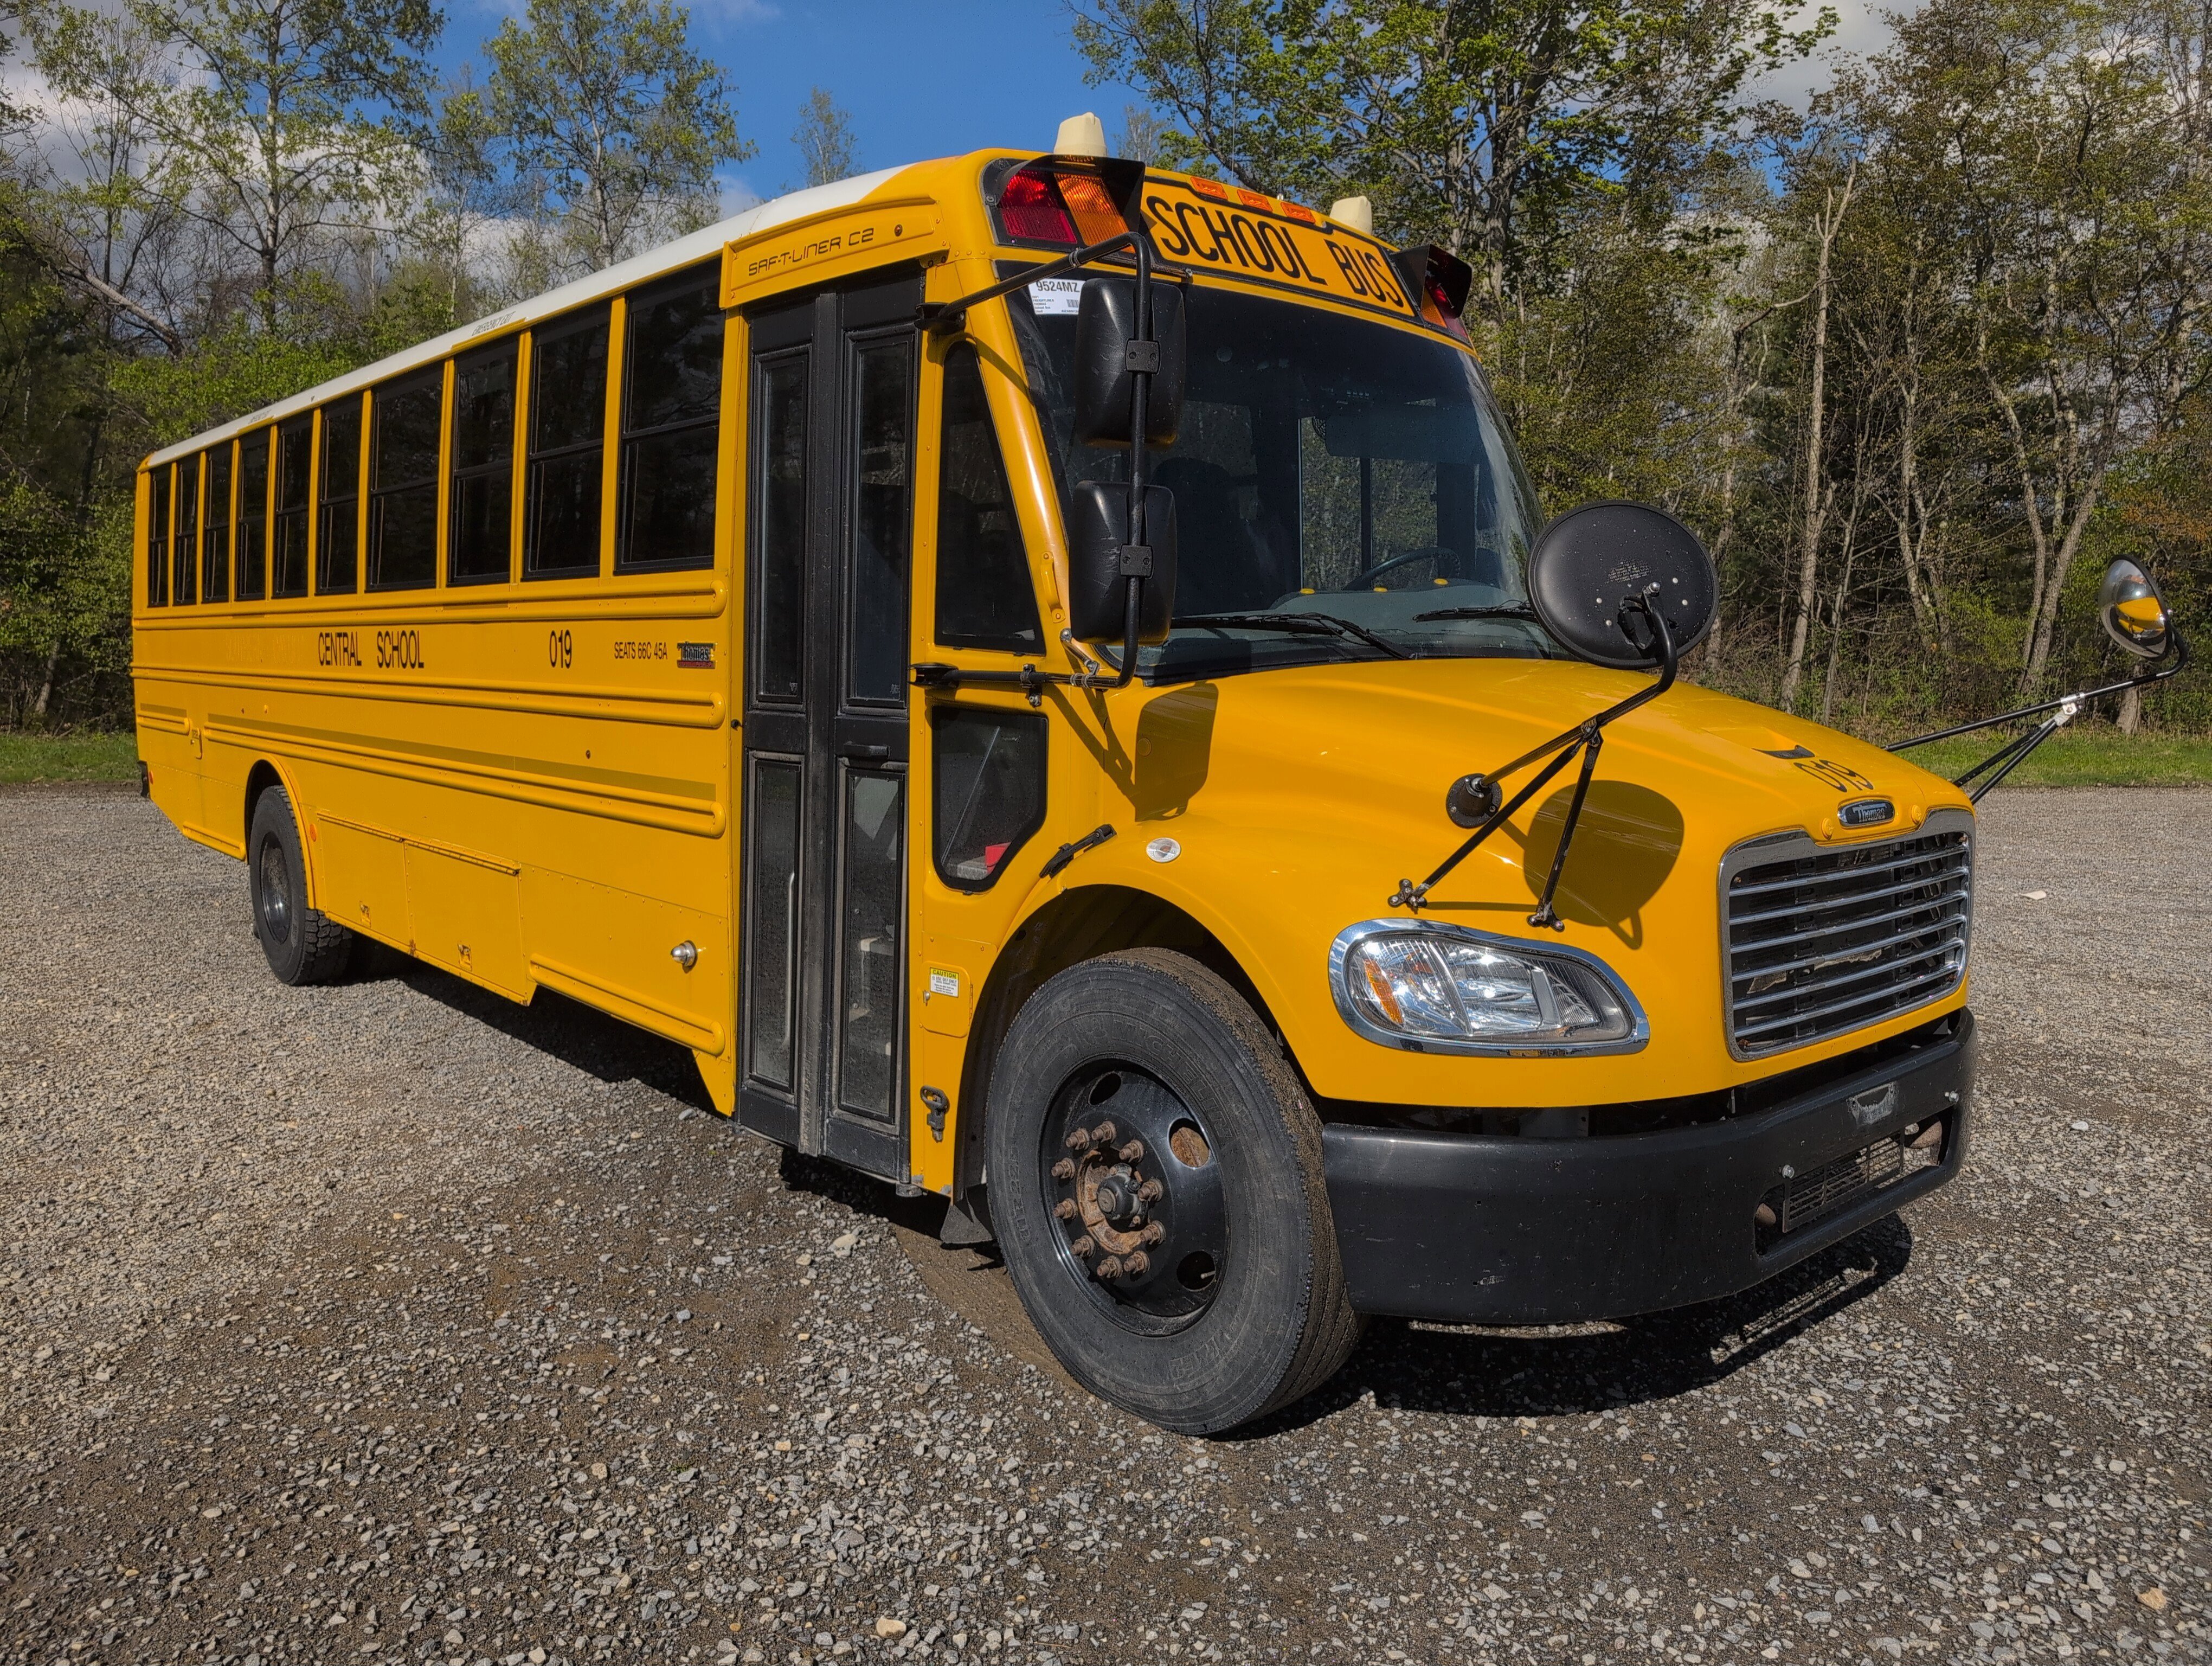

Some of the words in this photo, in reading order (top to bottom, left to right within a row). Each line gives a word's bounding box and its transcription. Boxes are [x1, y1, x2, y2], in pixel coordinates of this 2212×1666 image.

[748, 236, 841, 277] SAF-T-LINER
[848, 227, 874, 246] C2
[1146, 195, 1328, 286] SCHOOL
[1324, 238, 1404, 307] BUS
[1036, 281, 1080, 293] 9524MZ
[318, 632, 362, 667] CENTRAL
[377, 630, 425, 669] SCHOOL
[549, 629, 572, 669] 019
[614, 641, 636, 659] SEATS
[638, 642, 652, 659] 66C
[653, 642, 668, 659] 45A
[1793, 759, 1874, 793] 019
[1852, 803, 1888, 823] Thomas
[933, 969, 957, 979] CAUTION
[1111, 1020, 1233, 1139] MICHELIN
